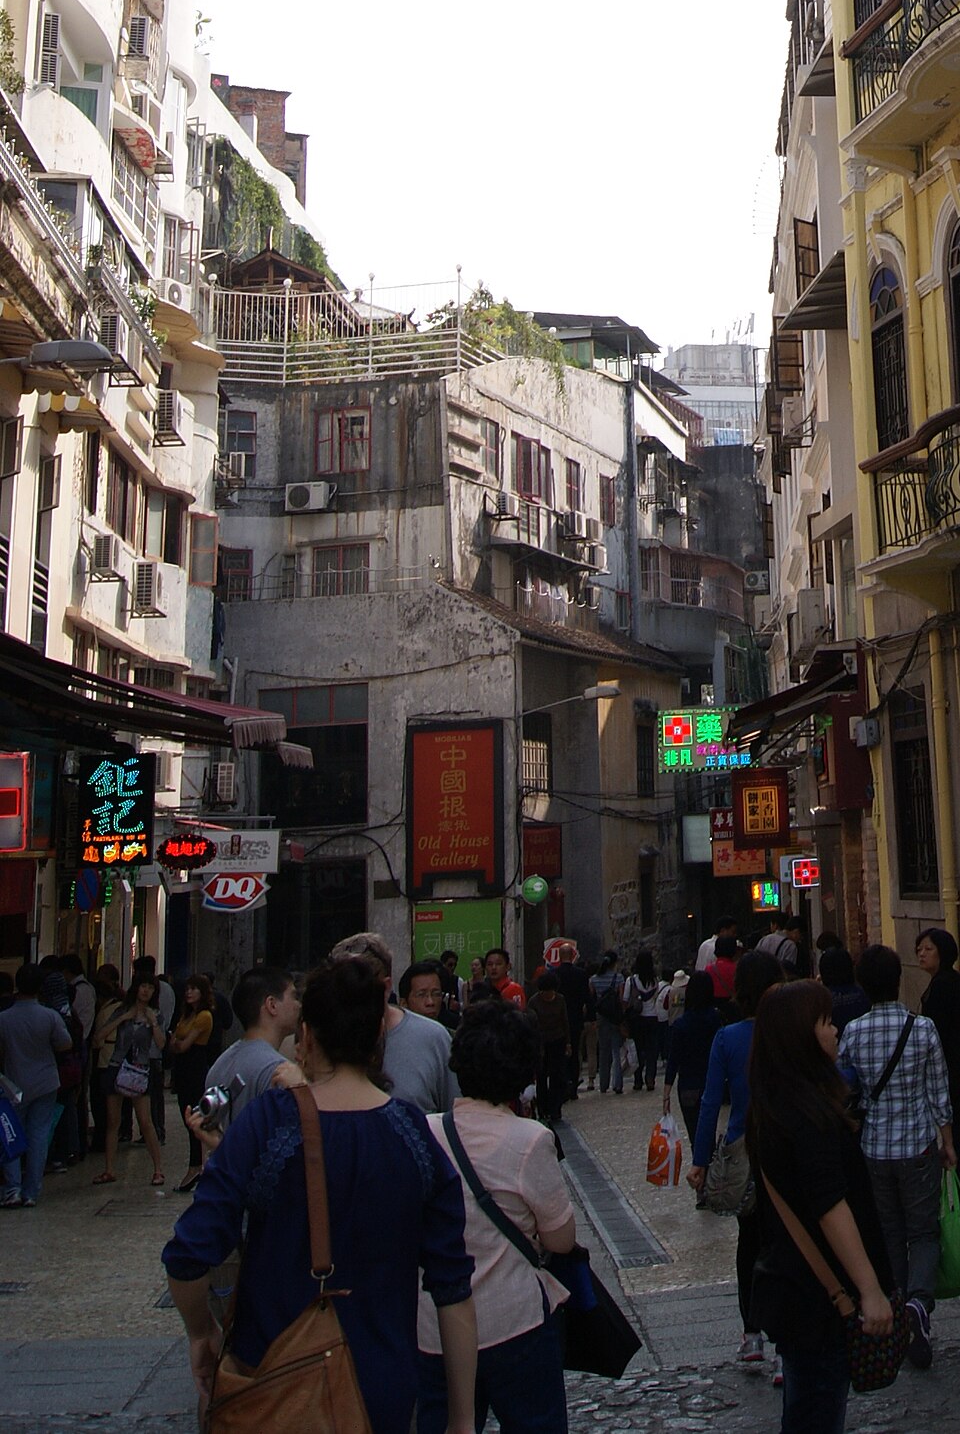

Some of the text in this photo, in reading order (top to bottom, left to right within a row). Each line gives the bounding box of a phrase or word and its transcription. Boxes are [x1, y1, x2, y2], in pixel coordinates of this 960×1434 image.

[696, 714, 722, 743] 藥
[435, 734, 472, 742] MOBILIAS
[664, 749, 693, 766] 非凡
[87, 758, 144, 835] 鉅記
[418, 834, 490, 850] Old House
[430, 852, 480, 868] Gallery
[213, 877, 257, 901] DQ
